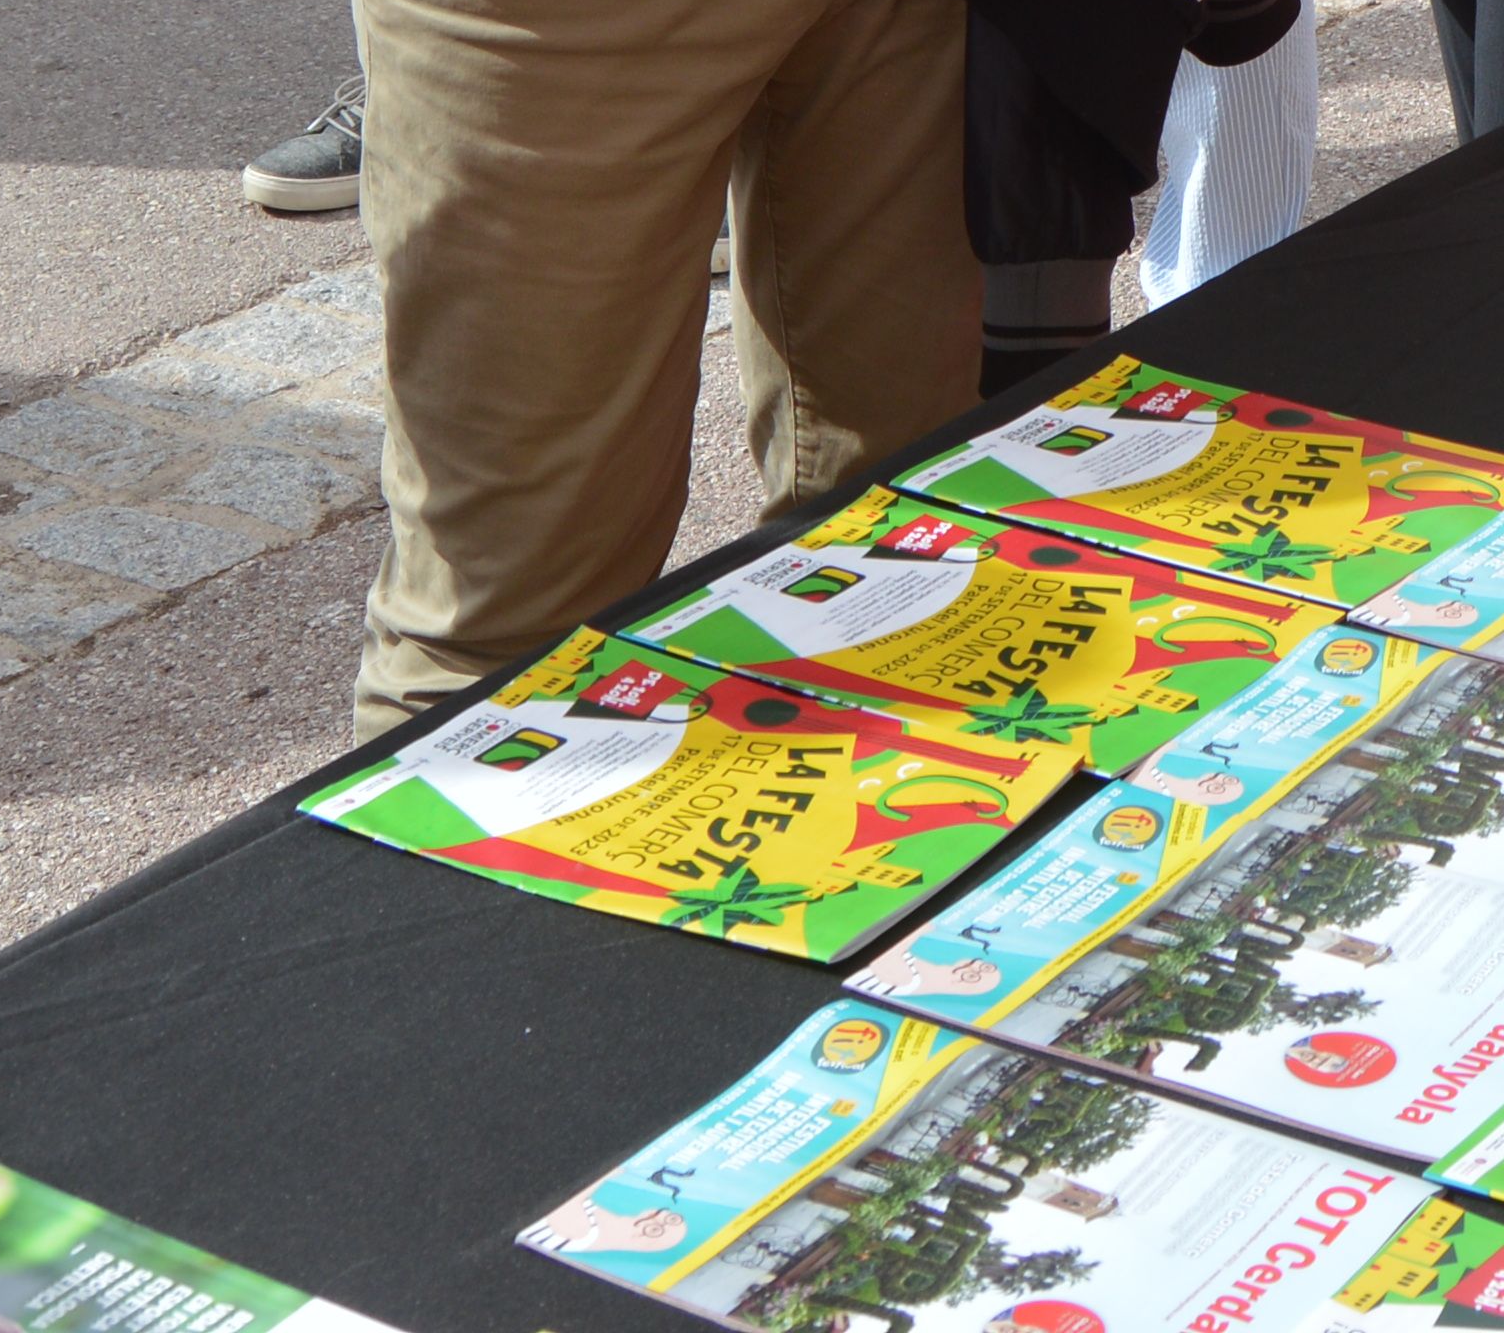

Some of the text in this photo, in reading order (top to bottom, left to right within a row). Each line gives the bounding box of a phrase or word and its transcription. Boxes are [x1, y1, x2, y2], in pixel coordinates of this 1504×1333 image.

[1155, 438, 1303, 529] DEL COMERÇ
[1199, 443, 1354, 538] LA FESTA
[850, 584, 990, 654] Parc del Turonet
[869, 572, 1029, 678] 17 DE SETEMBRE DE 2023
[903, 579, 1068, 689] DEL COMERÇ
[950, 585, 1123, 699] LA FESTA
[548, 746, 701, 827] Parc del Turonet
[567, 734, 743, 857] 17 DE SETEMBRE DE 2023
[605, 741, 786, 869] DEL COMERÇ
[655, 746, 845, 880] LA FESTA
[715, 1094, 832, 1172] INTERNACIONAL
[756, 1115, 833, 1165] FESTIVAL
[1293, 1169, 1391, 1245] TOT
